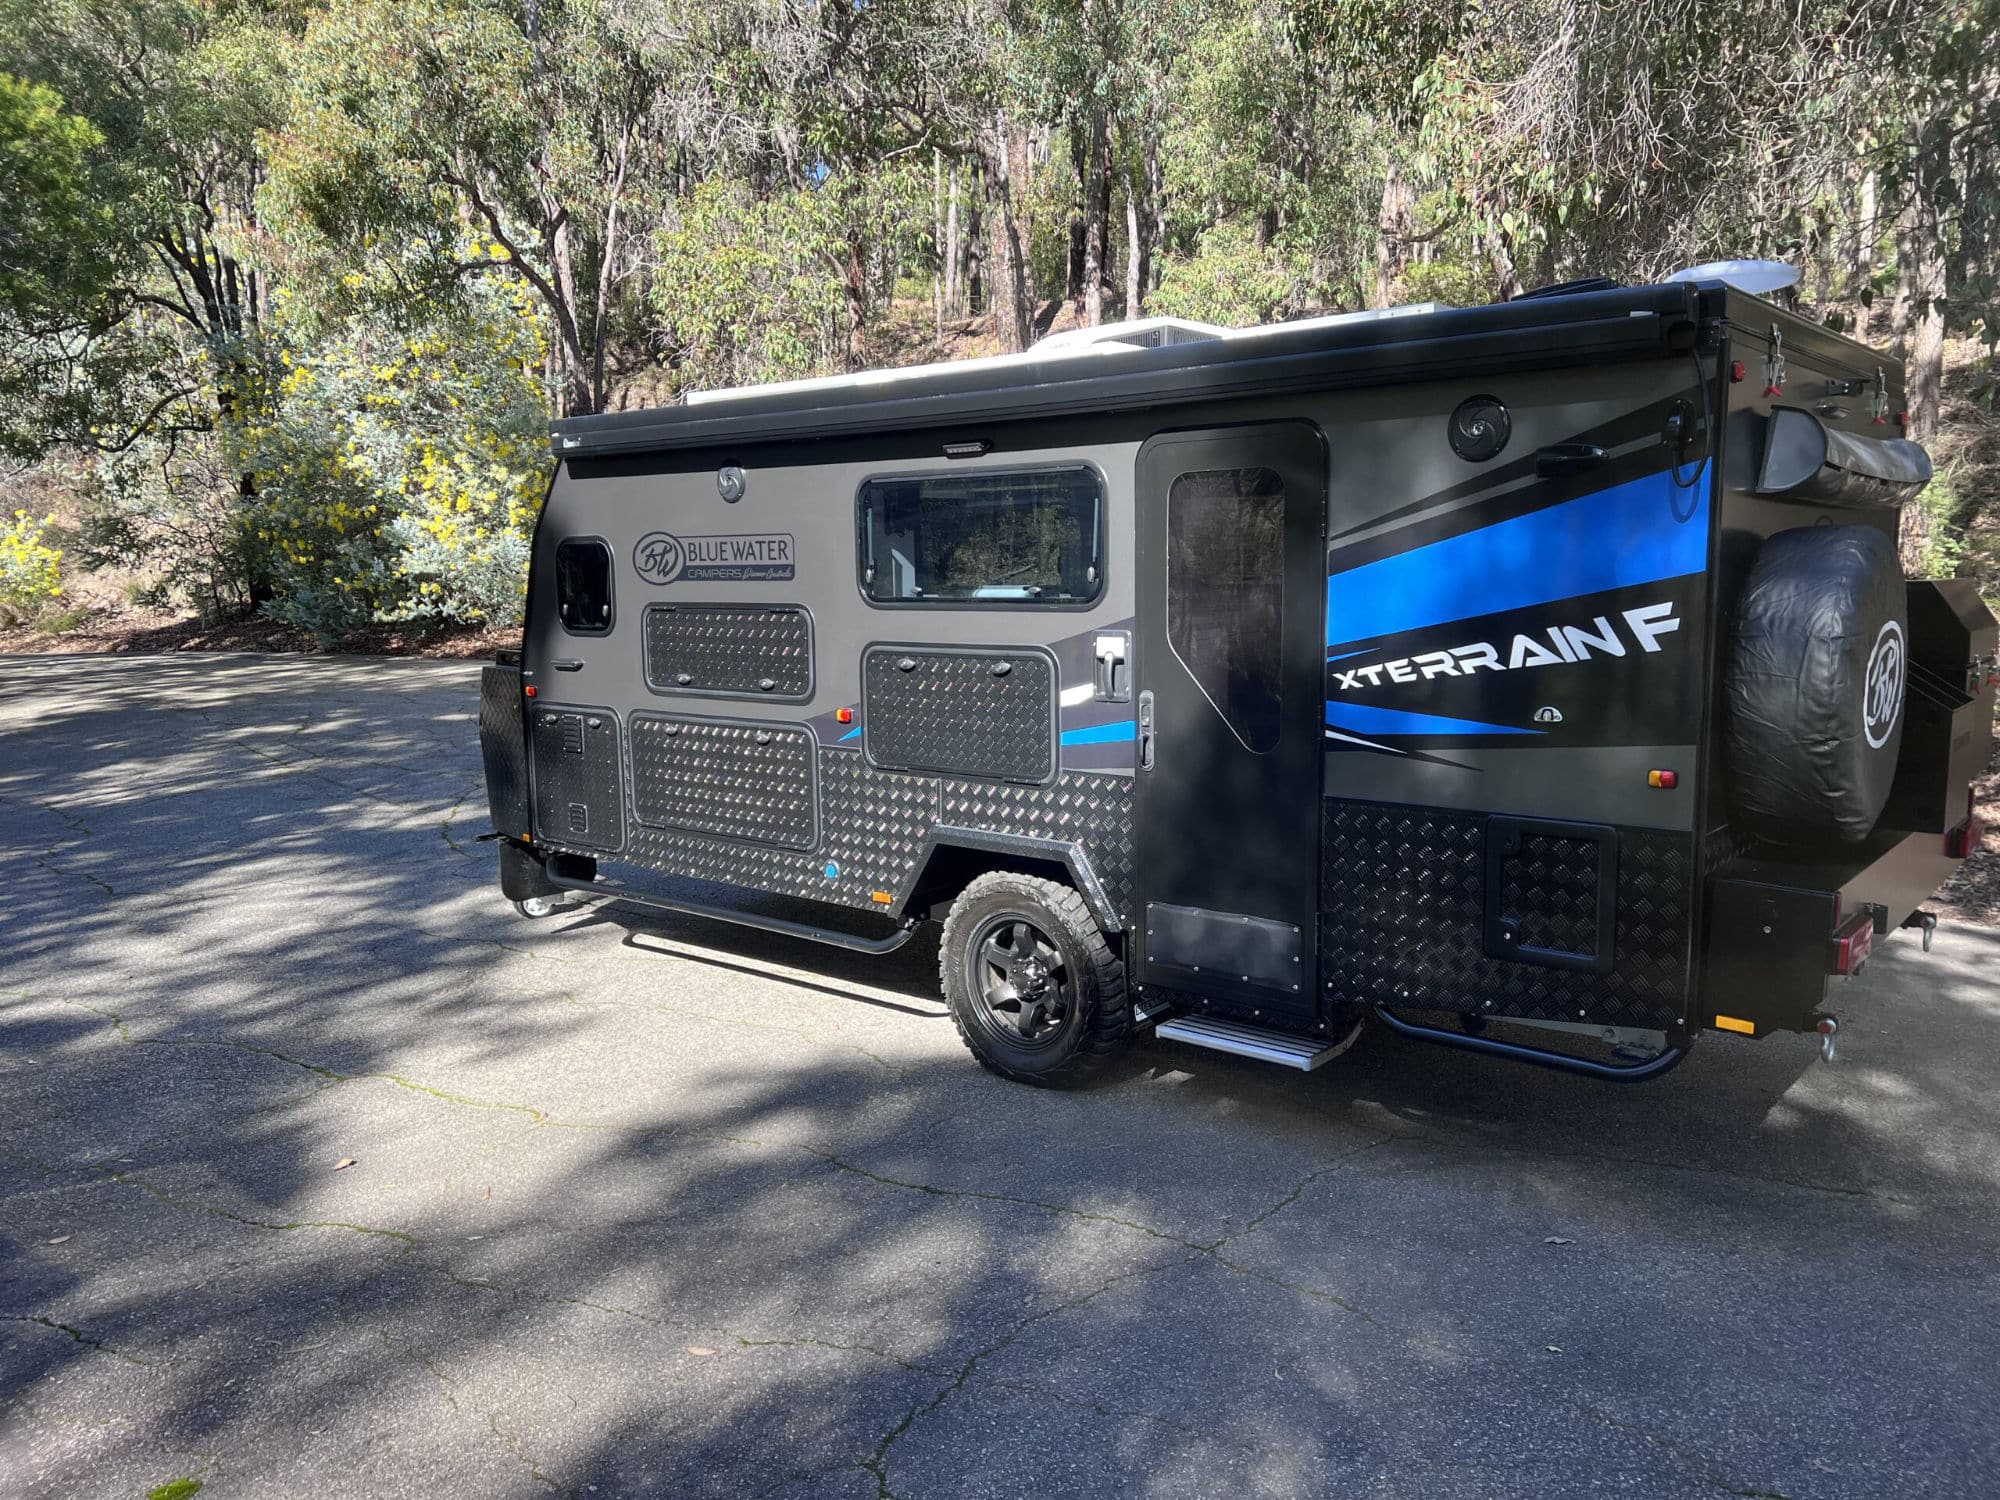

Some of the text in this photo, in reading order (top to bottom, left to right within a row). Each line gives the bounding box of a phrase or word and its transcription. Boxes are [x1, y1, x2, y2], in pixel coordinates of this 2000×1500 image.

[687, 540, 789, 562] BLUEWATER
[687, 568, 742, 579] CAMPERS
[1331, 600, 1682, 690] XTERRAIN F
